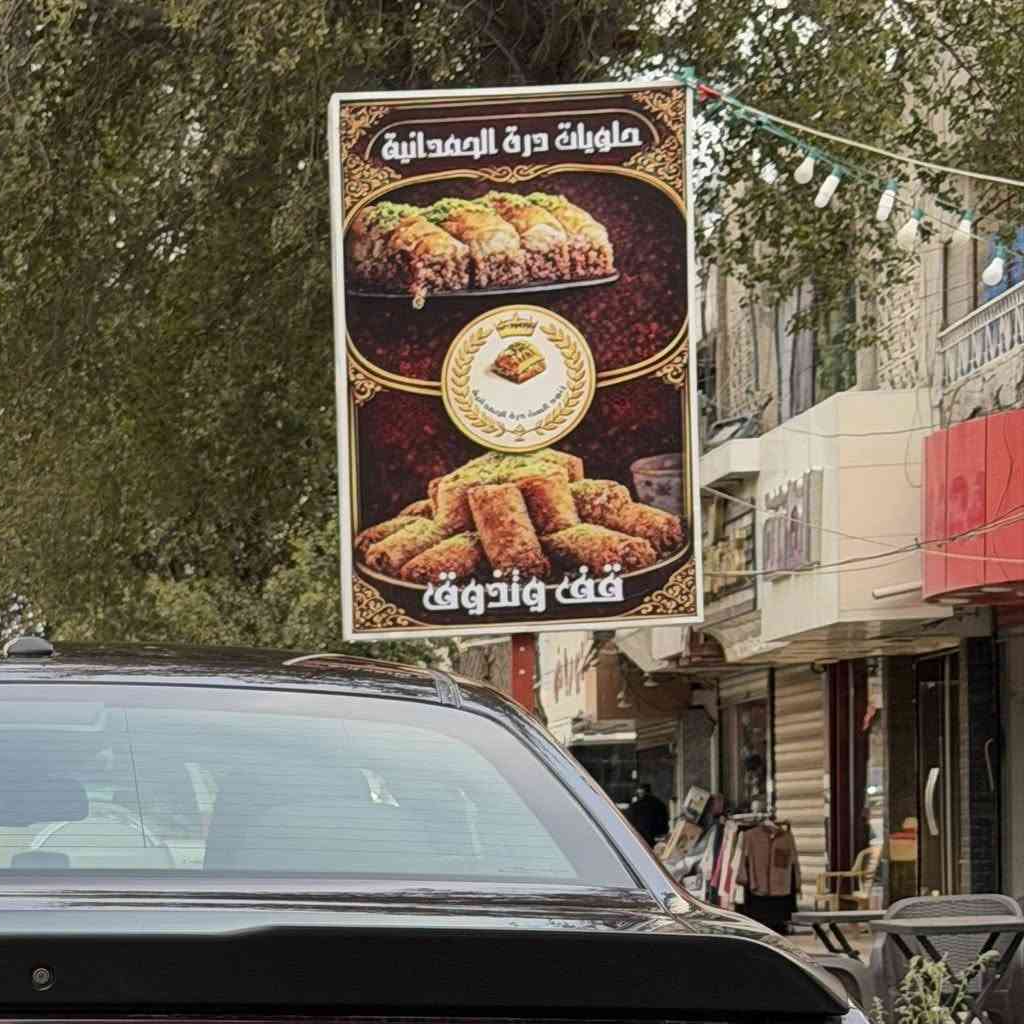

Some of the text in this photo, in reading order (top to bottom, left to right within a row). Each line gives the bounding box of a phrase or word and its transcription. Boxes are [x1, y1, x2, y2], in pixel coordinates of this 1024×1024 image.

[380, 120, 643, 164] حلويات درة الحمدانية
[555, 563, 625, 604] قف
